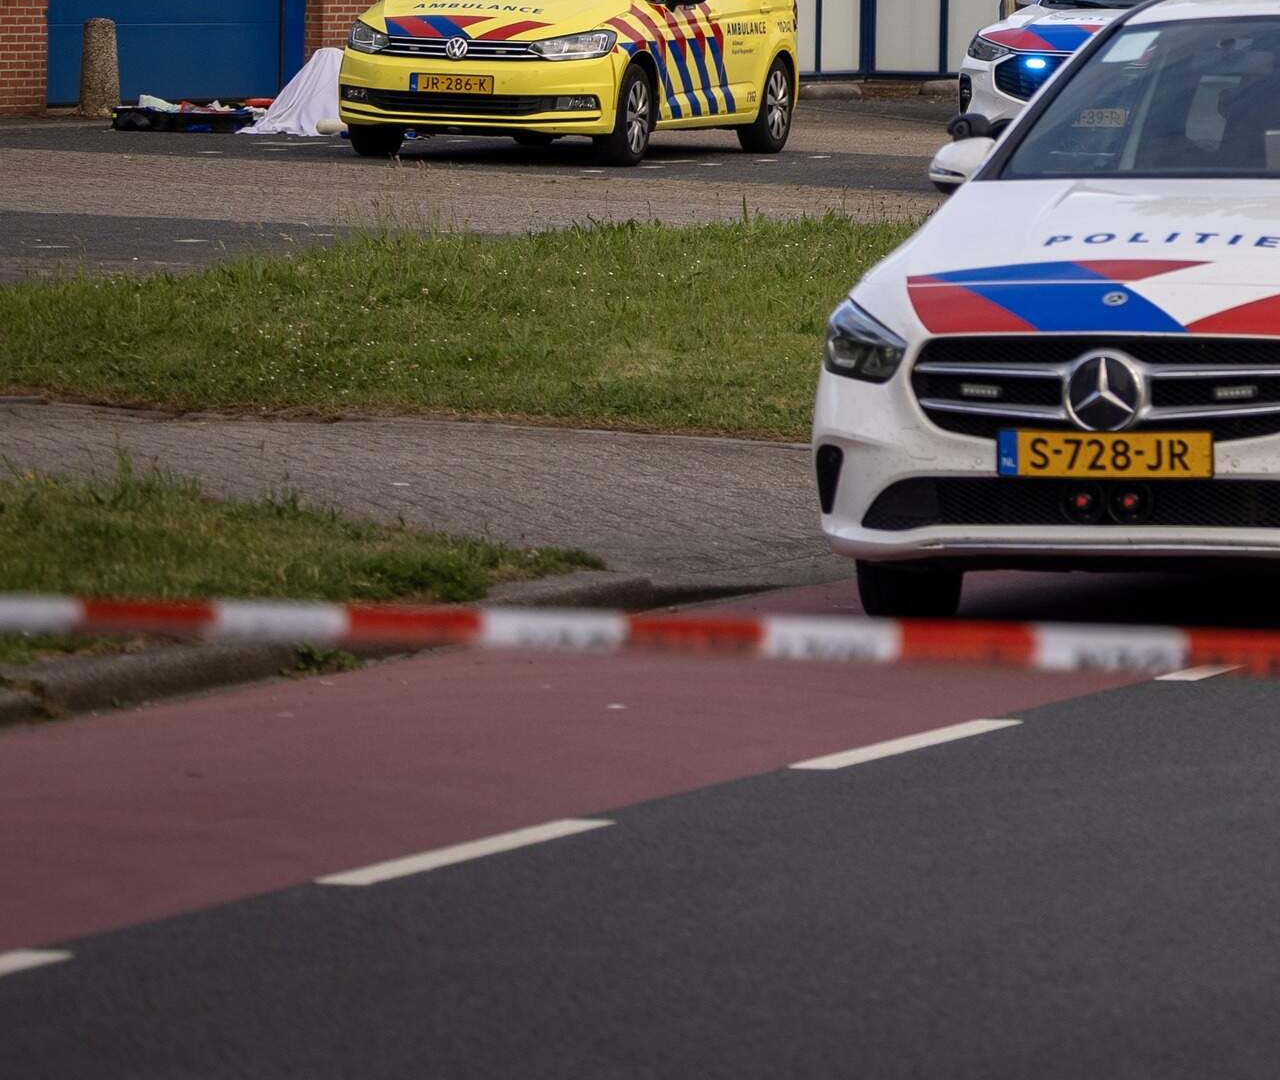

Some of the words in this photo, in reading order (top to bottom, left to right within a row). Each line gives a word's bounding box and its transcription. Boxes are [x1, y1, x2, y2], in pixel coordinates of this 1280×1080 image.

[414, 3, 544, 14] AMBULANCE
[726, 21, 767, 35] AMBULANCE
[423, 77, 487, 92] JR-286-K
[1029, 437, 1190, 471] S-728-JR
